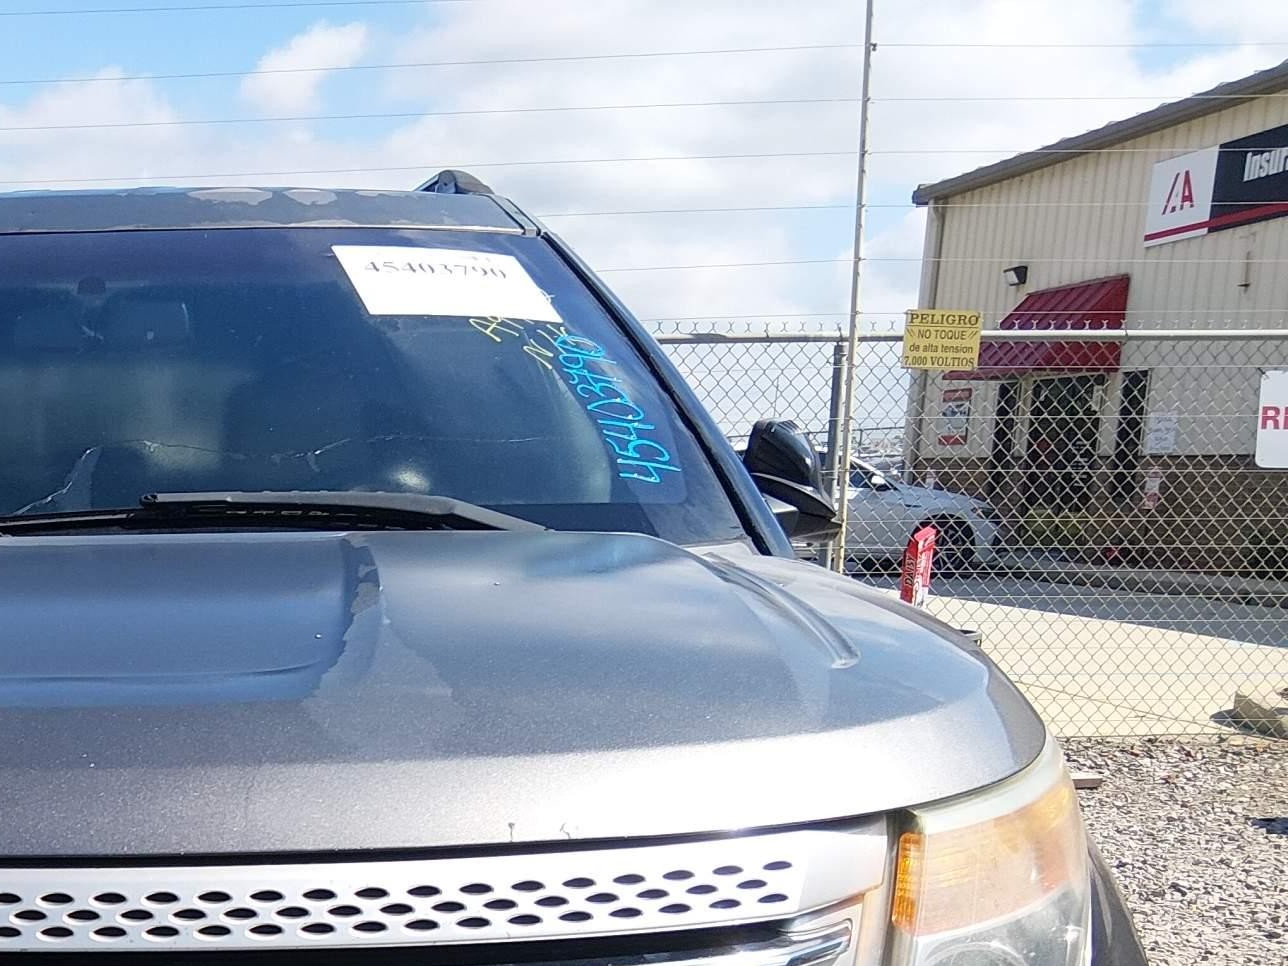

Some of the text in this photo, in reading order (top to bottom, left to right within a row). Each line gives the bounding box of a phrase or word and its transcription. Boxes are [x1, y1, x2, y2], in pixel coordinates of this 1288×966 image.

[1243, 147, 1288, 182] Insur
[909, 313, 979, 326] PELIGRO
[917, 328, 967, 340] NO TOQUE
[909, 343, 974, 353] de alta tension
[904, 356, 975, 367] 7.000 VOLTIOS
[555, 335, 681, 482] 45403790
